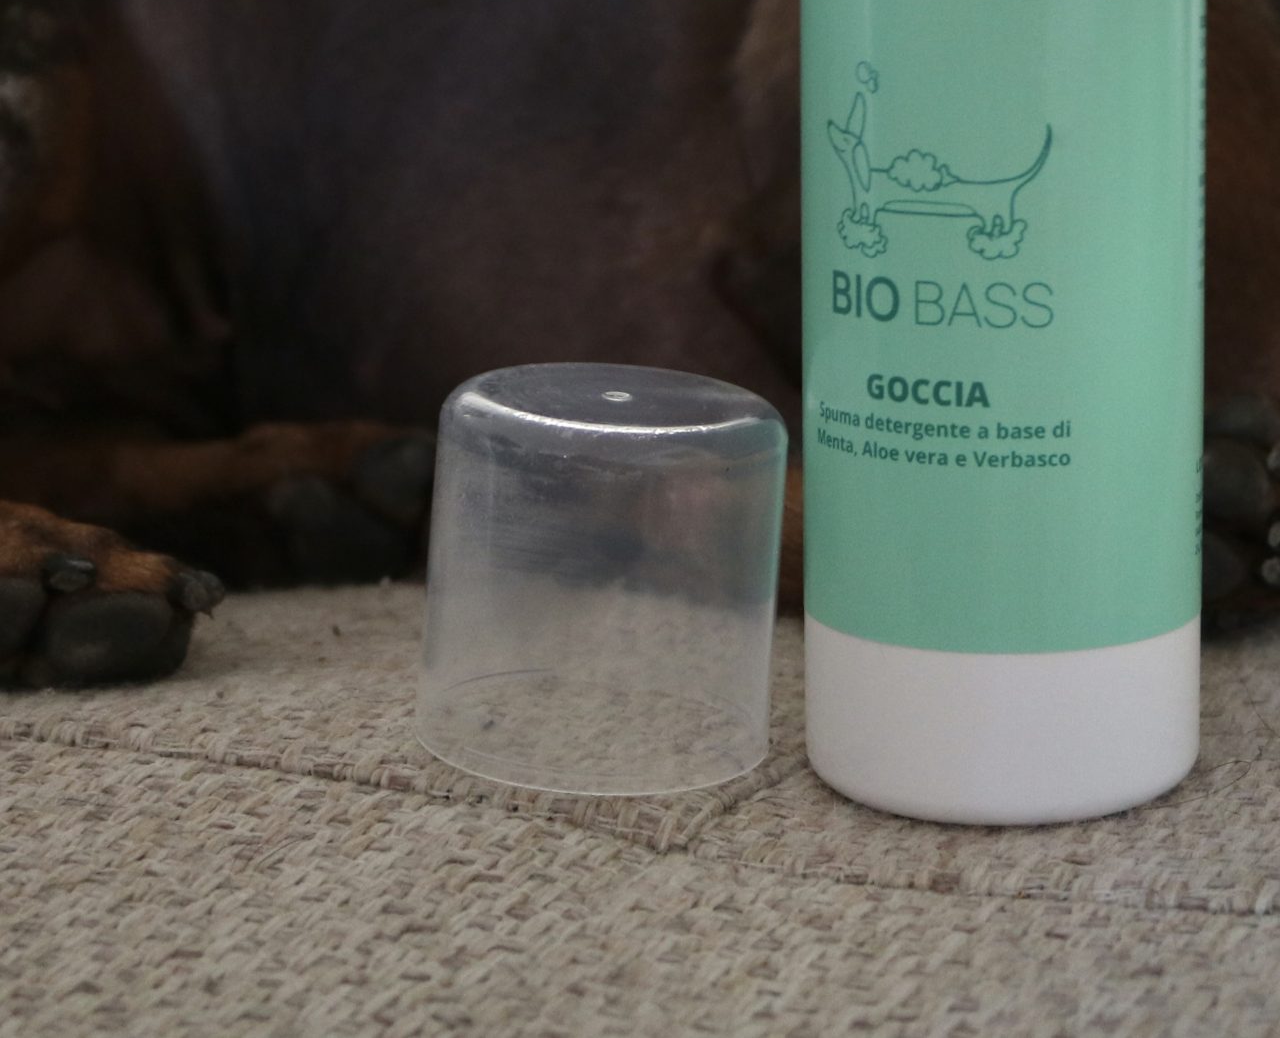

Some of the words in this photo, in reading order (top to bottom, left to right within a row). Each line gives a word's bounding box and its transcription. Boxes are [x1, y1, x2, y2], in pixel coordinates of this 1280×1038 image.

[832, 270, 900, 322] BIO
[915, 281, 1054, 329] BASS
[866, 373, 990, 408] GOCCIA
[819, 401, 861, 427] Spuma
[865, 412, 971, 440] detergente
[978, 425, 989, 438] a
[996, 421, 1045, 439] base
[1052, 420, 1071, 438] di
[817, 428, 857, 456] Menta,
[862, 442, 899, 461] Aloe
[905, 450, 948, 466] vera
[956, 453, 966, 466] e
[974, 451, 1071, 468] Verbasco
